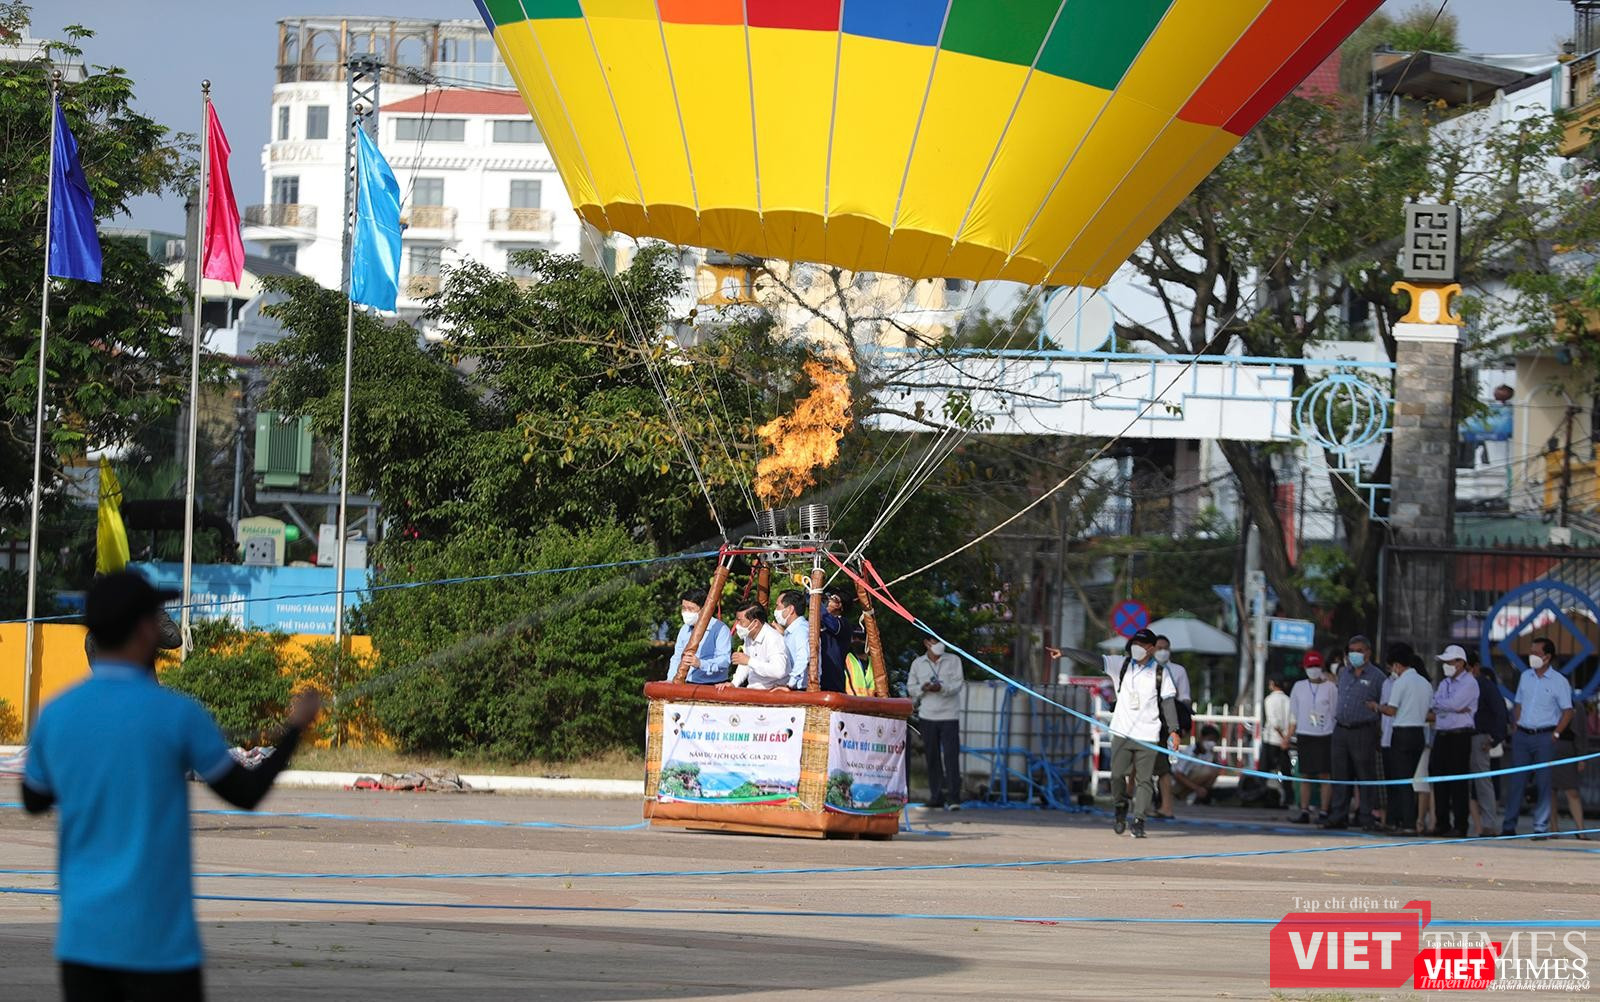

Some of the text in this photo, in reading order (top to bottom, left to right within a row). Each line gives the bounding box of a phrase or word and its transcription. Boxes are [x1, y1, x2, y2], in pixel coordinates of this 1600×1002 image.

[276, 604, 301, 613] TRUNG
[303, 603, 319, 613] TÂM
[294, 621, 315, 630] THAO
[705, 730, 719, 742] HỘI
[723, 732, 749, 741] KHINH
[752, 731, 767, 742] KHÍ
[689, 751, 704, 759] NĂM
[714, 752, 730, 760] LỊCH
[730, 751, 748, 760] QUỐC
